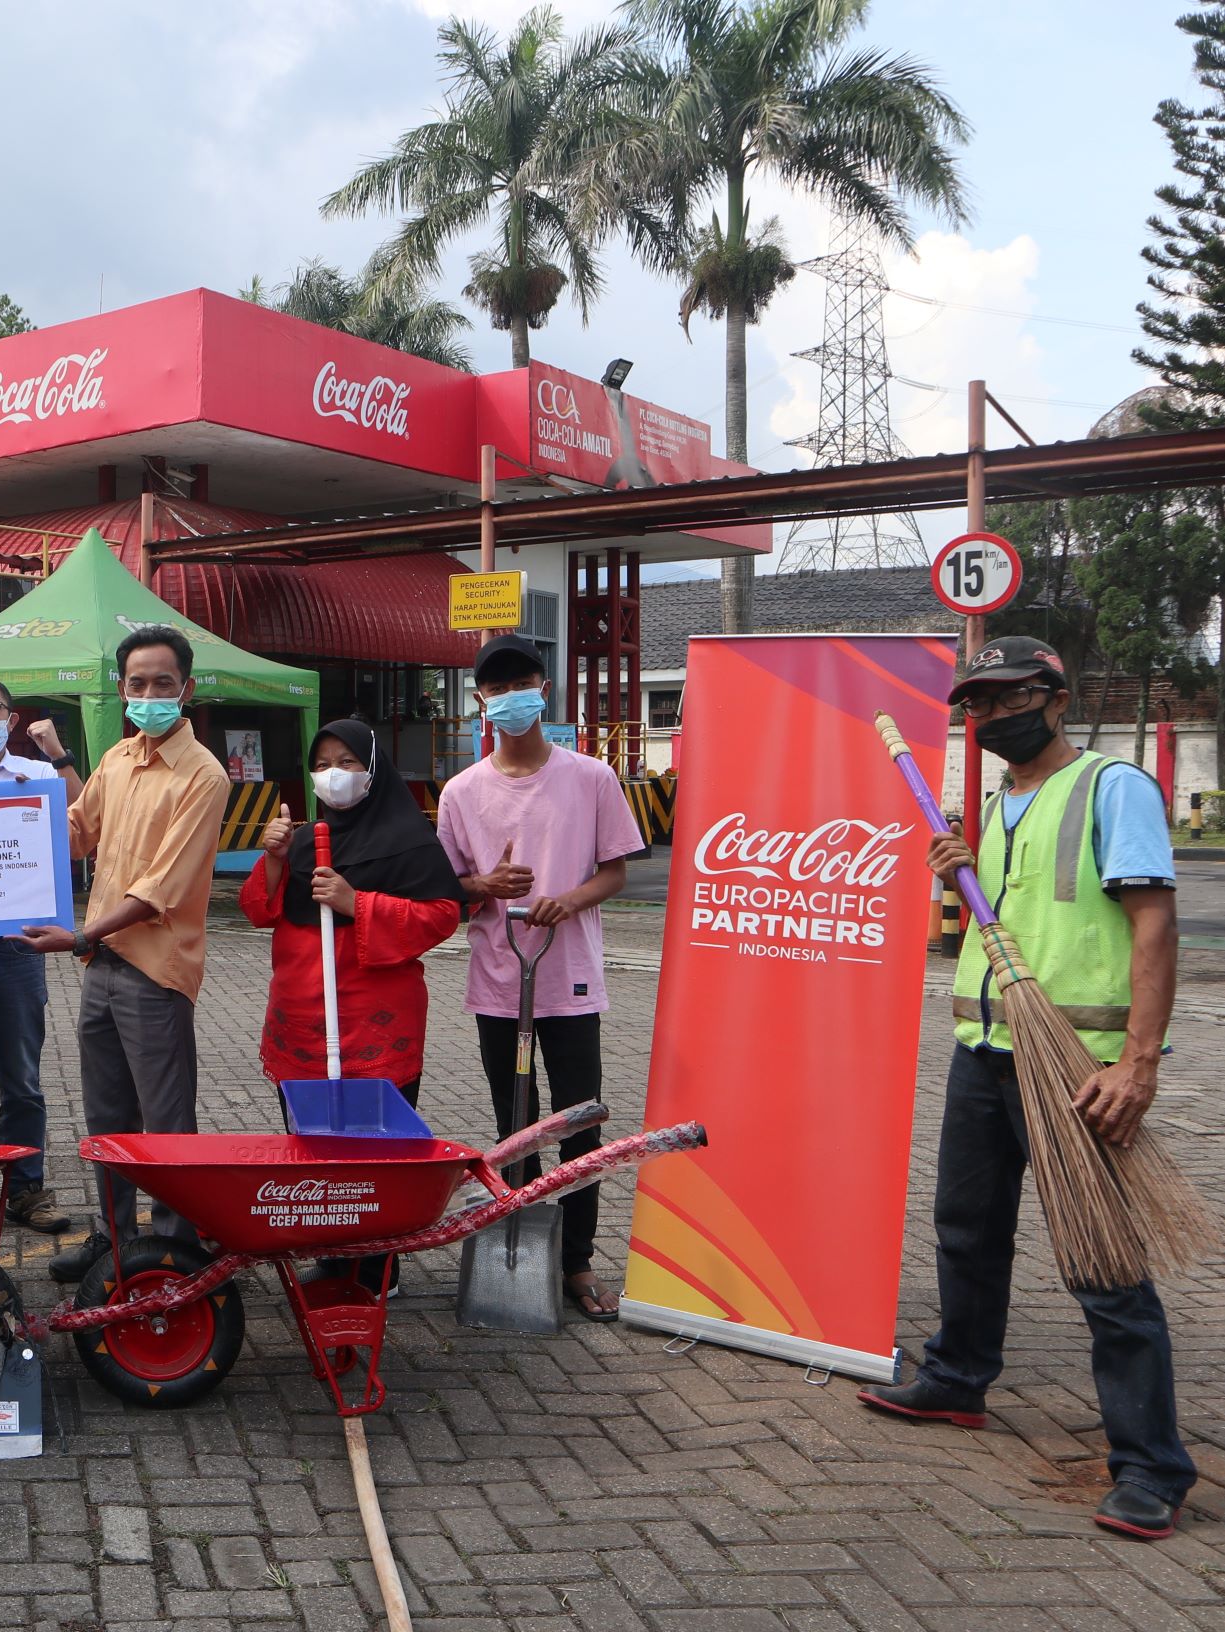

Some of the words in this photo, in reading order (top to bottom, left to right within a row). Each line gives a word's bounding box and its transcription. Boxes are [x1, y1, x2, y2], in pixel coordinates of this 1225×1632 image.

[313, 361, 410, 436] Coca-Cola
[538, 380, 581, 424] CCA
[538, 417, 582, 450] COCA-COLA
[582, 431, 612, 458] AMATIL
[538, 443, 566, 463] INDONESIA
[946, 550, 984, 598] 15
[460, 580, 510, 589] PENGECEKAN
[465, 590, 501, 598] SECURITY
[479, 602, 516, 610] TUNJUKAN
[453, 614, 472, 622] STNK
[473, 612, 517, 620] KENDARAAN
[972, 648, 1004, 666] CCA
[58, 668, 93, 681] frestea
[205, 674, 217, 685] teh
[288, 683, 314, 695] frestea
[694, 812, 915, 888] Coca-Cola
[694, 882, 888, 919] EUROPACIFIC
[691, 908, 886, 947] PARTNERS
[738, 942, 827, 963] INDONESIA
[256, 1180, 329, 1201] Coca-Cola
[328, 1181, 375, 1189] EUROPACIFIC
[251, 1205, 290, 1215] BANTUAN
[292, 1205, 325, 1214] SARANA
[327, 1203, 379, 1213] KEBERSIHAN
[269, 1215, 299, 1227] CCEP
[302, 1214, 360, 1226] INDONESIA
[324, 1319, 368, 1331] ARTCO
